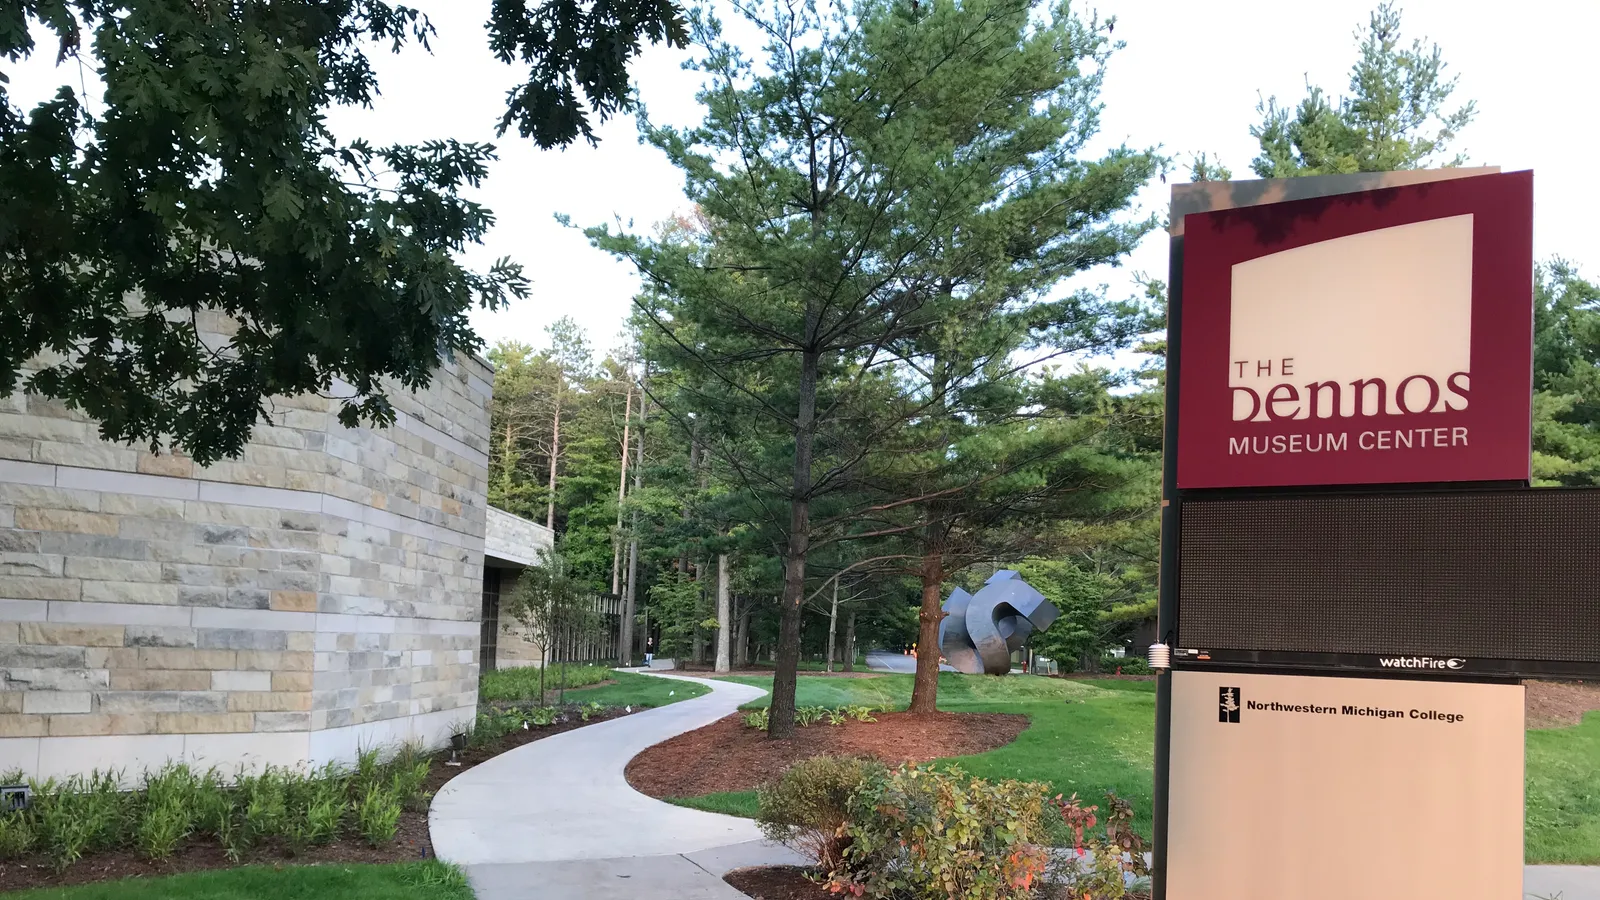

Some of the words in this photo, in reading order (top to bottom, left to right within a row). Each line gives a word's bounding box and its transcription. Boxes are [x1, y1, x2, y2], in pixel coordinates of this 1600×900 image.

[1234, 357, 1294, 378] THE
[1229, 372, 1471, 422] Dennos
[1229, 432, 1348, 455] MUSEUM
[1359, 427, 1469, 450] CENTER
[1246, 700, 1337, 715] Northwestern
[1341, 705, 1405, 720] Michigan
[1409, 709, 1465, 724] College
